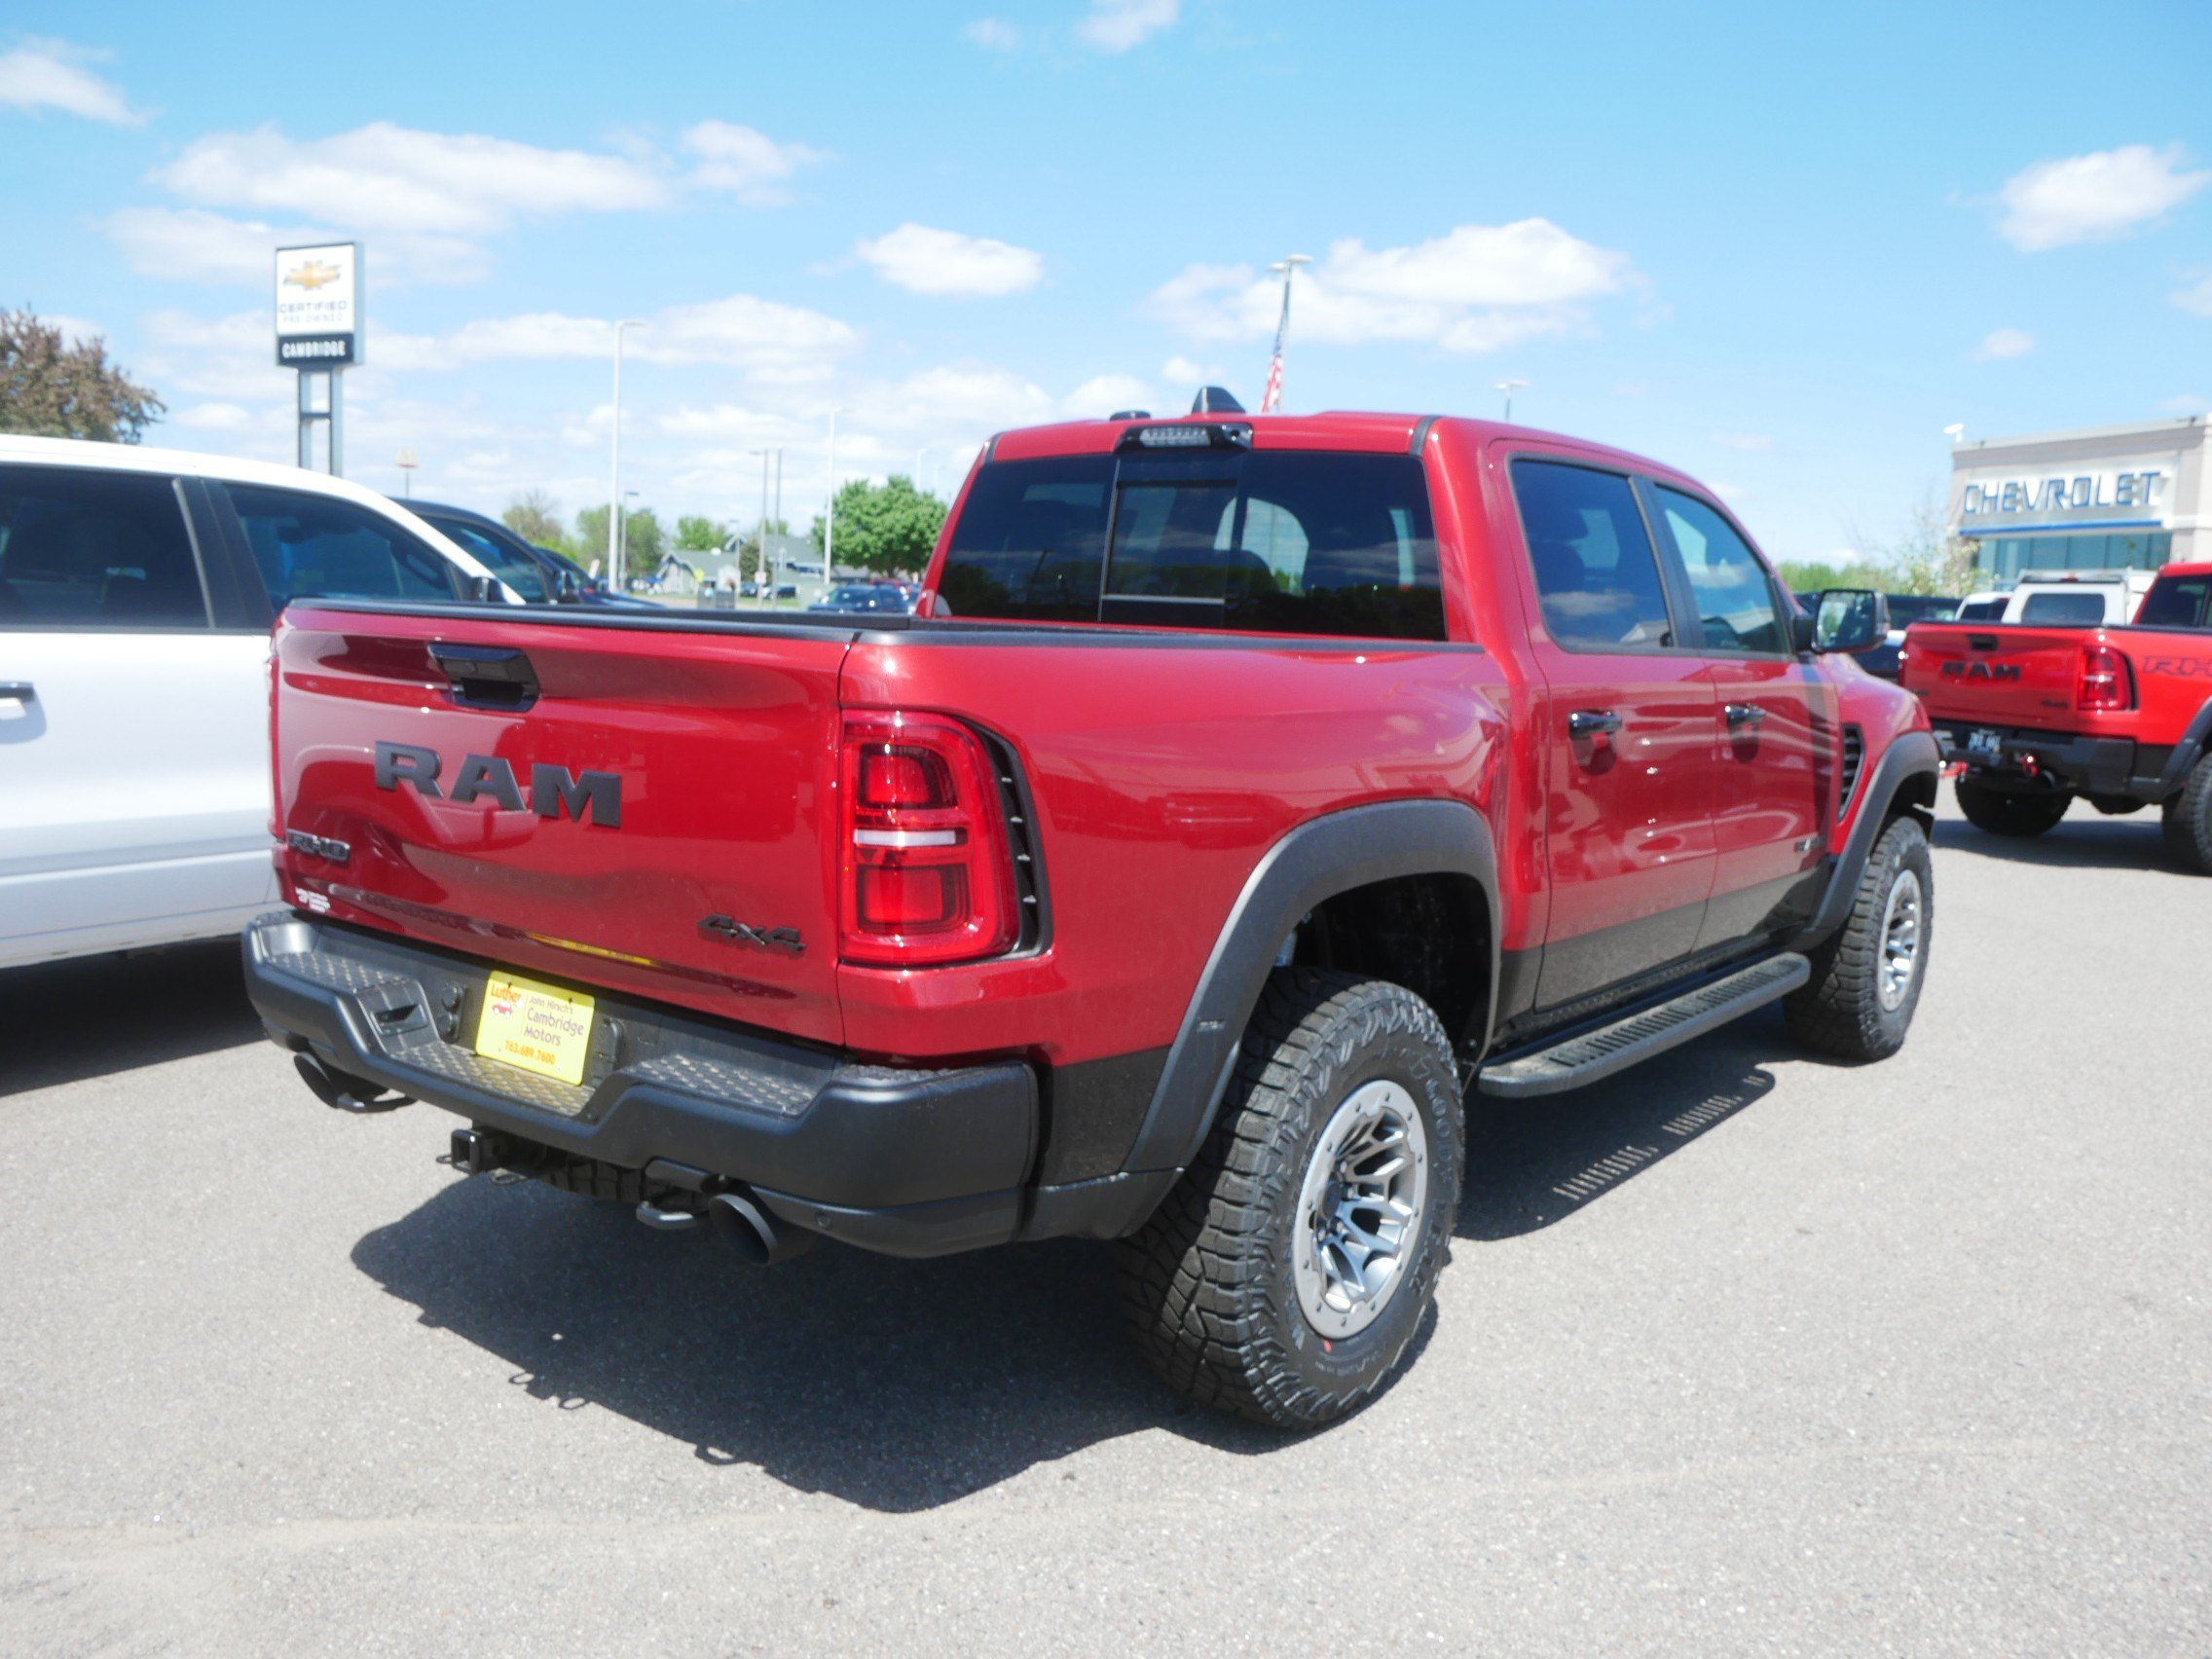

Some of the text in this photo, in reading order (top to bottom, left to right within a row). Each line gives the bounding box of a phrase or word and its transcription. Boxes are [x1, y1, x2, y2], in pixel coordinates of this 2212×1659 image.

[281, 340, 346, 358] CAMBRIDGE
[1964, 471, 2167, 514] CHEVROLET
[1942, 661, 2021, 681] RAM
[376, 741, 621, 829] RAM
[527, 1007, 584, 1037] Cambridge
[524, 1025, 562, 1046] Motors
